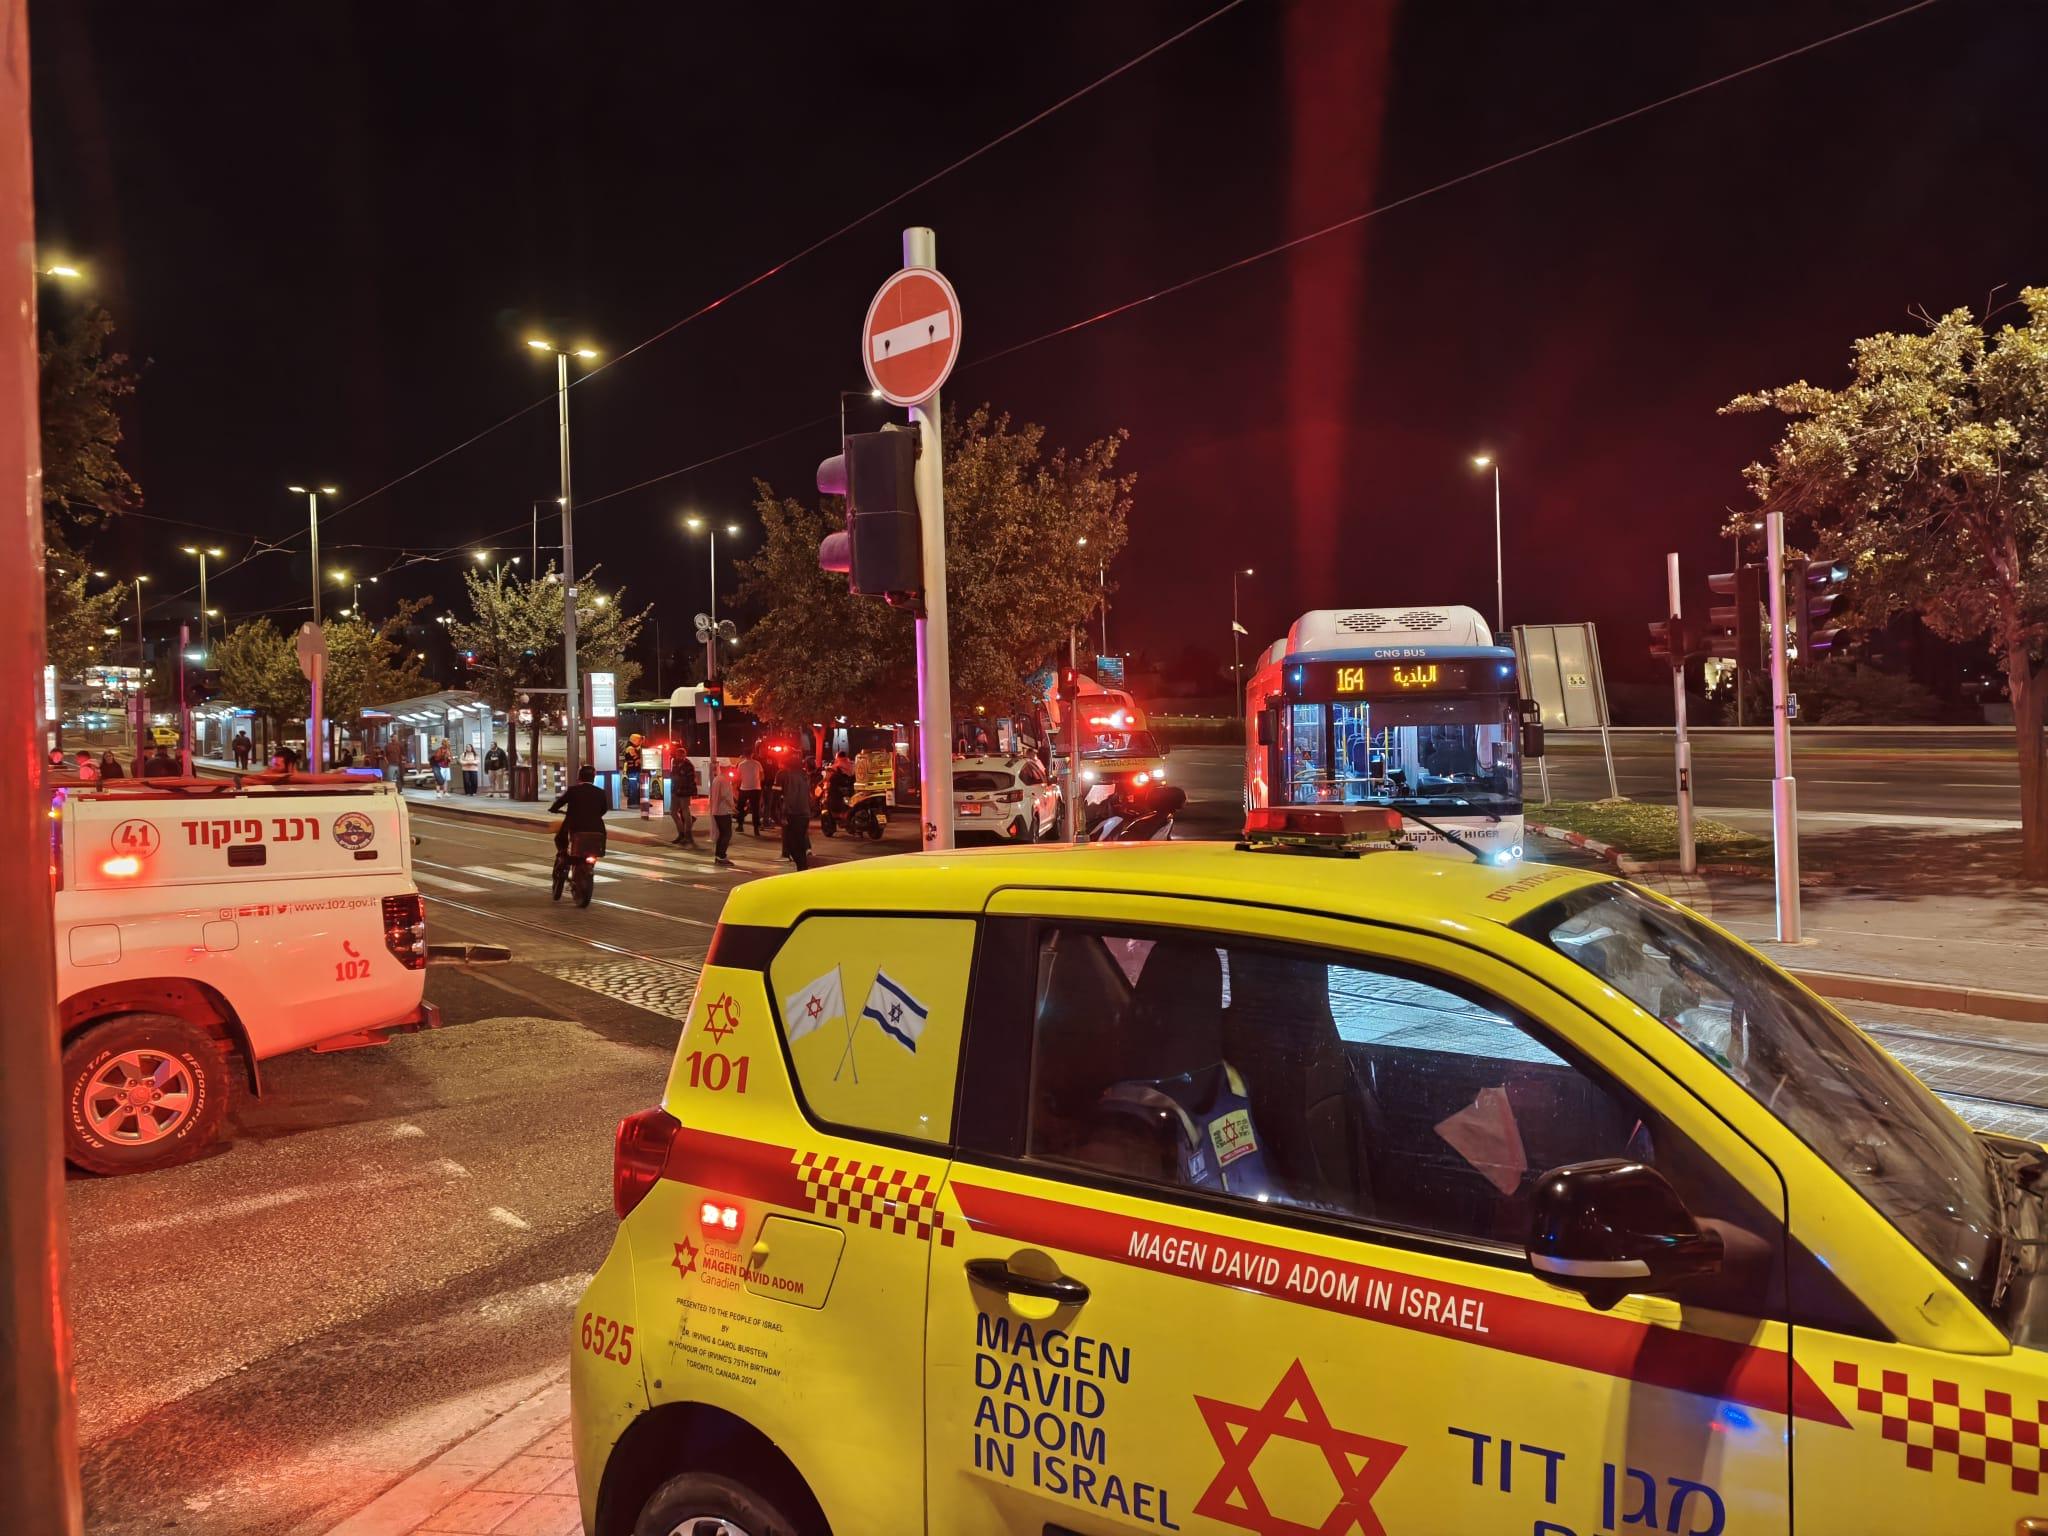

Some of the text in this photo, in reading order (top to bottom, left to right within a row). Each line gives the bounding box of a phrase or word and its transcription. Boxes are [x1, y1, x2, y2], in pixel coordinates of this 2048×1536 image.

[1375, 649, 1425, 658] CNG BUS
[1337, 667, 1364, 691] 164
[121, 825, 150, 847] 41
[182, 819, 262, 849] פיקוד
[272, 817, 320, 841] רכב
[1464, 830, 1499, 839] HIGER
[294, 897, 377, 911] www.102.gov.il
[335, 960, 371, 981] 102
[686, 1051, 750, 1094] 101
[72, 1050, 111, 1149] All-Terrain T/A
[177, 1053, 206, 1139] BFGoodrich
[704, 1244, 743, 1263] Canadian
[700, 1271, 740, 1293] Canadien
[703, 1257, 804, 1294] MAGEN DAVID ADOM
[1127, 1231, 1490, 1333] MAGEN DAVID ADOM IN ISRAEL
[676, 1297, 784, 1333] PRESENTED TO THE PEOPLE OF ISRAEL
[721, 1325, 729, 1333] BY
[581, 1312, 634, 1366] 6525
[692, 1331, 711, 1343] IRVING
[717, 1338, 736, 1351] CAROL
[738, 1344, 768, 1359] BURSTEIN
[975, 1311, 1131, 1384] MAGEN
[675, 1341, 698, 1355] HONOUR
[699, 1348, 706, 1356] OF
[707, 1351, 732, 1365] IRVING'S
[733, 1358, 749, 1368] 75TH
[750, 1362, 781, 1377] BIRTHDAY
[686, 1360, 757, 1386] TORONTO, CANADA 2024
[975, 1353, 1106, 1419] DAVID
[974, 1396, 1107, 1465] ADOM
[974, 1433, 1181, 1531] IN ISRAEL
[1448, 1427, 1726, 1536] מגן דוד
